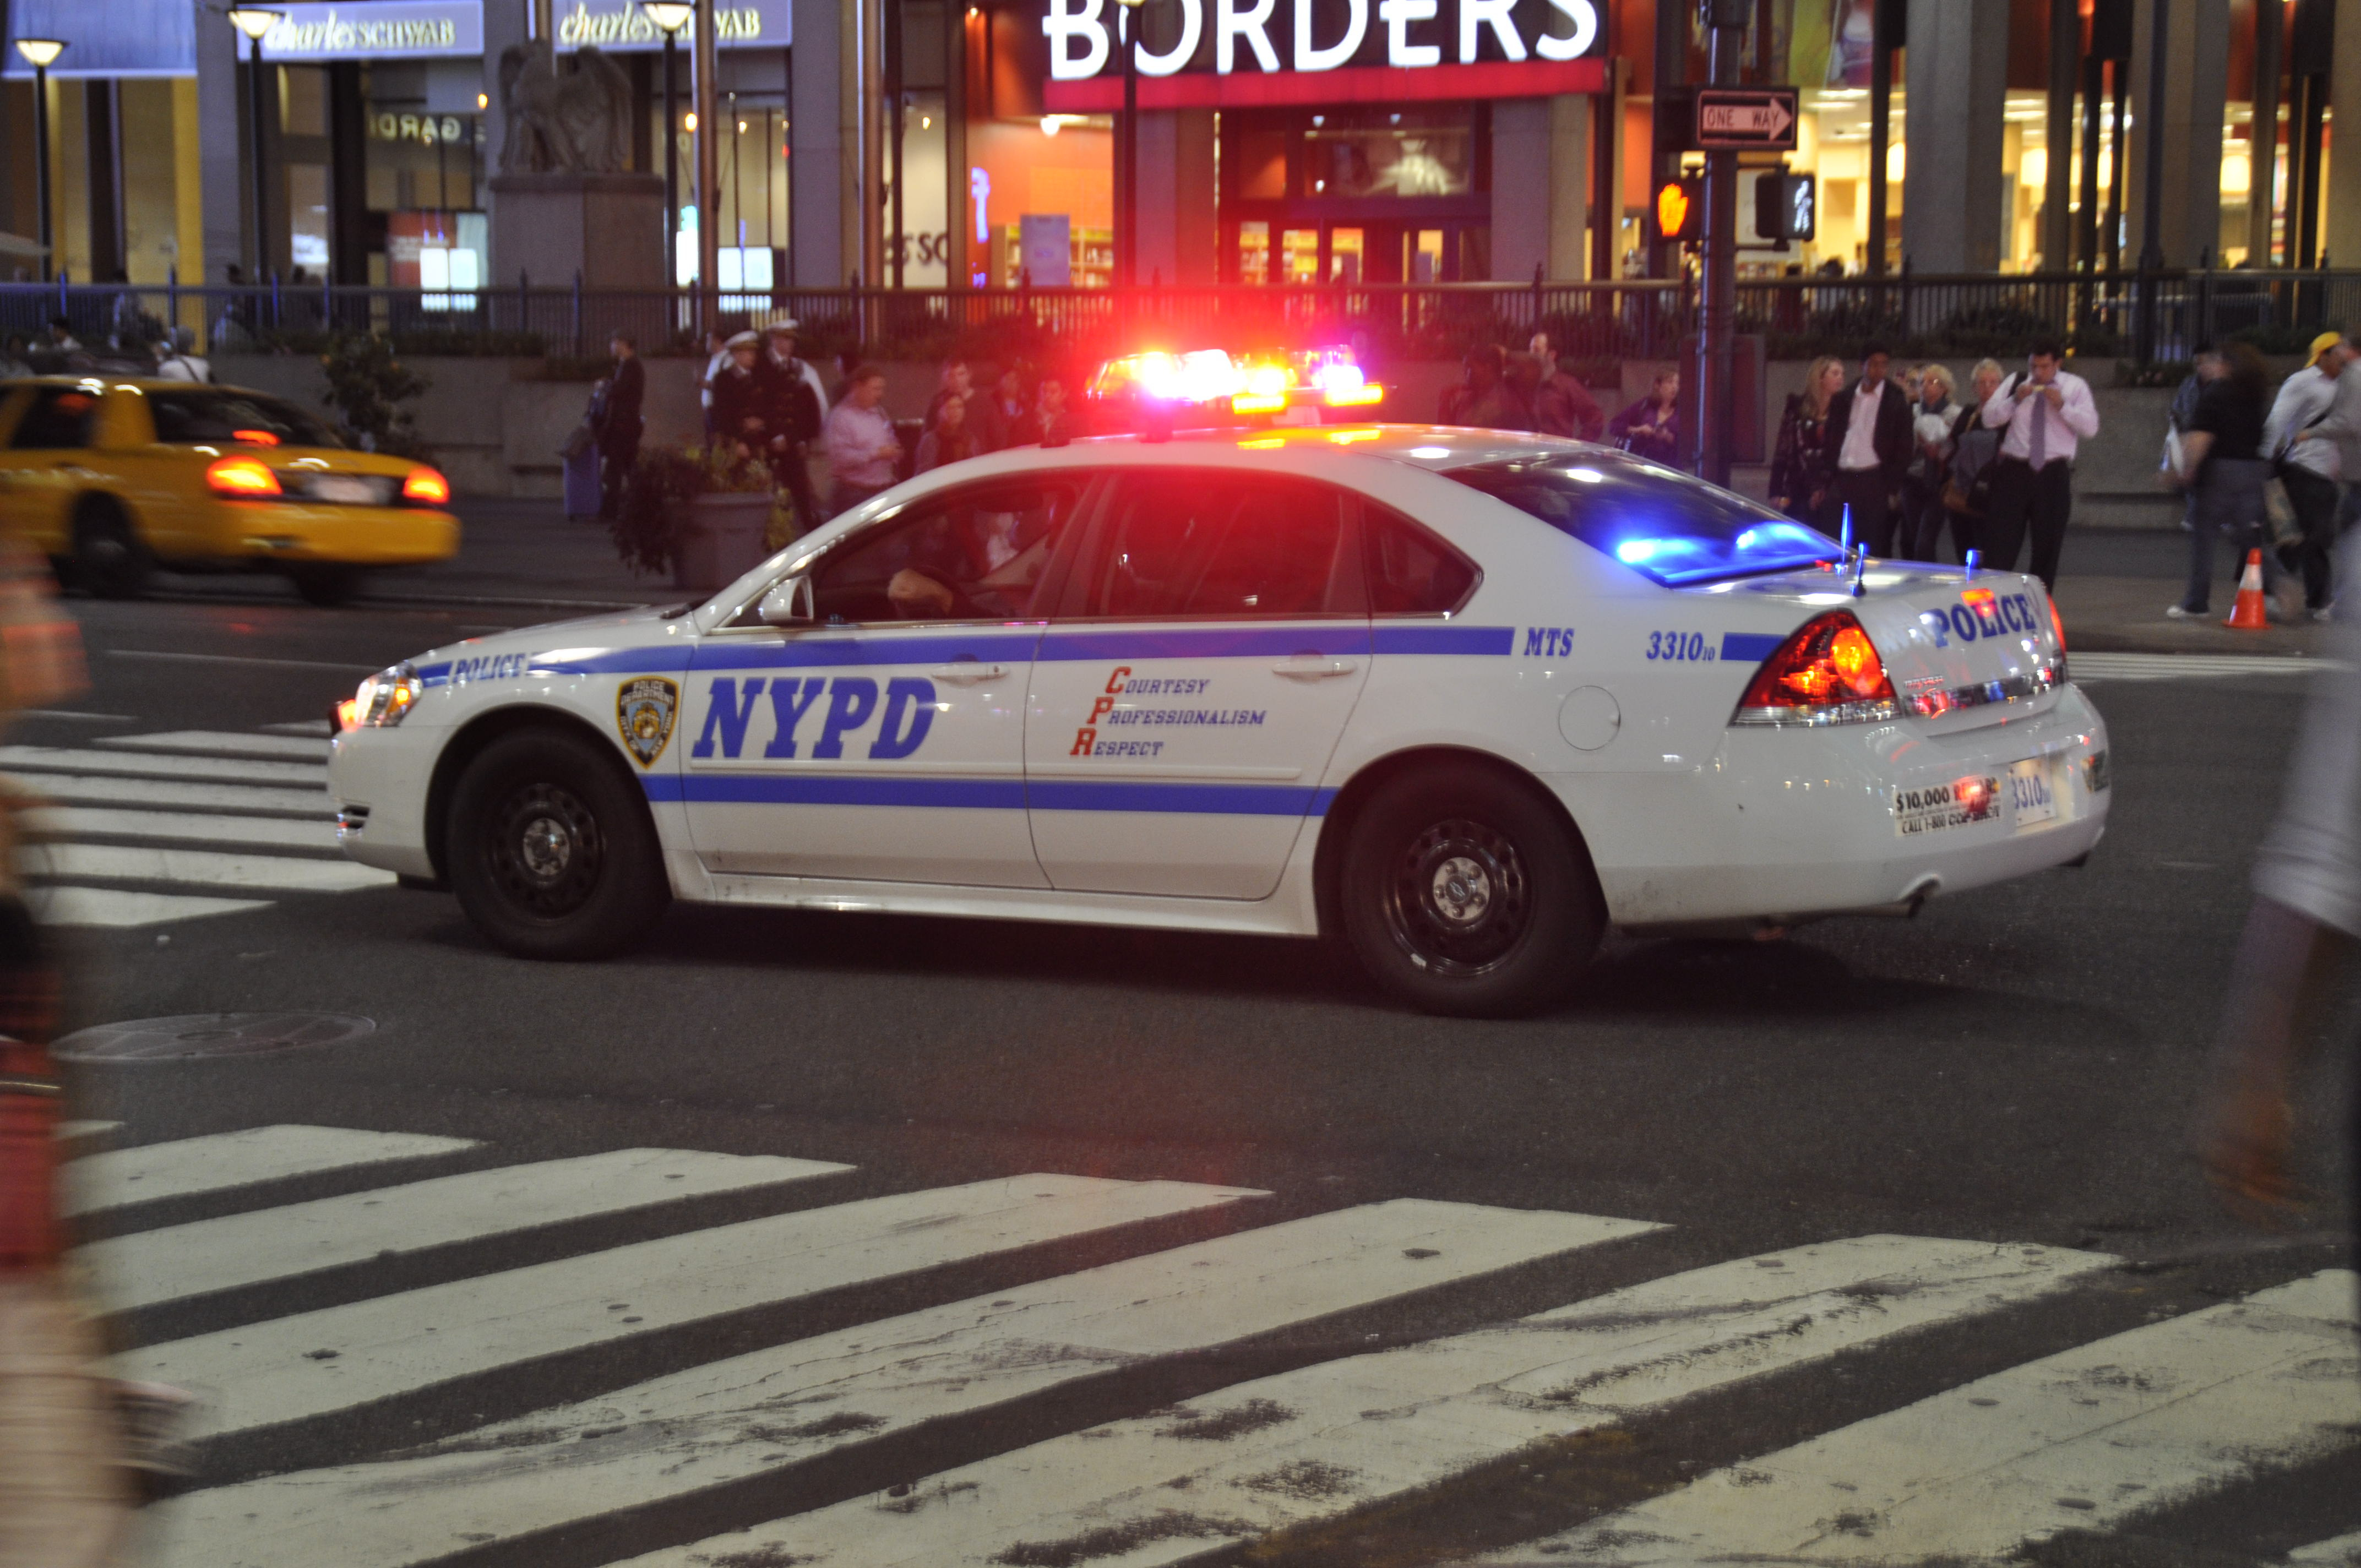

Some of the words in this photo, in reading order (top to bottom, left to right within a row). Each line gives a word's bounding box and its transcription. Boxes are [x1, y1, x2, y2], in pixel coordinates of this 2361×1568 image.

[1043, 0, 1597, 80] BORDERS
[1707, 110, 1733, 127] ONE
[1753, 110, 1779, 127] WAY
[1919, 592, 2037, 648] POLICE
[1524, 627, 1574, 657] MTS
[1646, 630, 1704, 661] 3310
[452, 651, 526, 683] POLICE
[692, 677, 936, 759] NYPD
[1896, 786, 1950, 813] $10,000
[1902, 818, 1922, 834] CALL
[1925, 814, 1946, 830] 1-800
